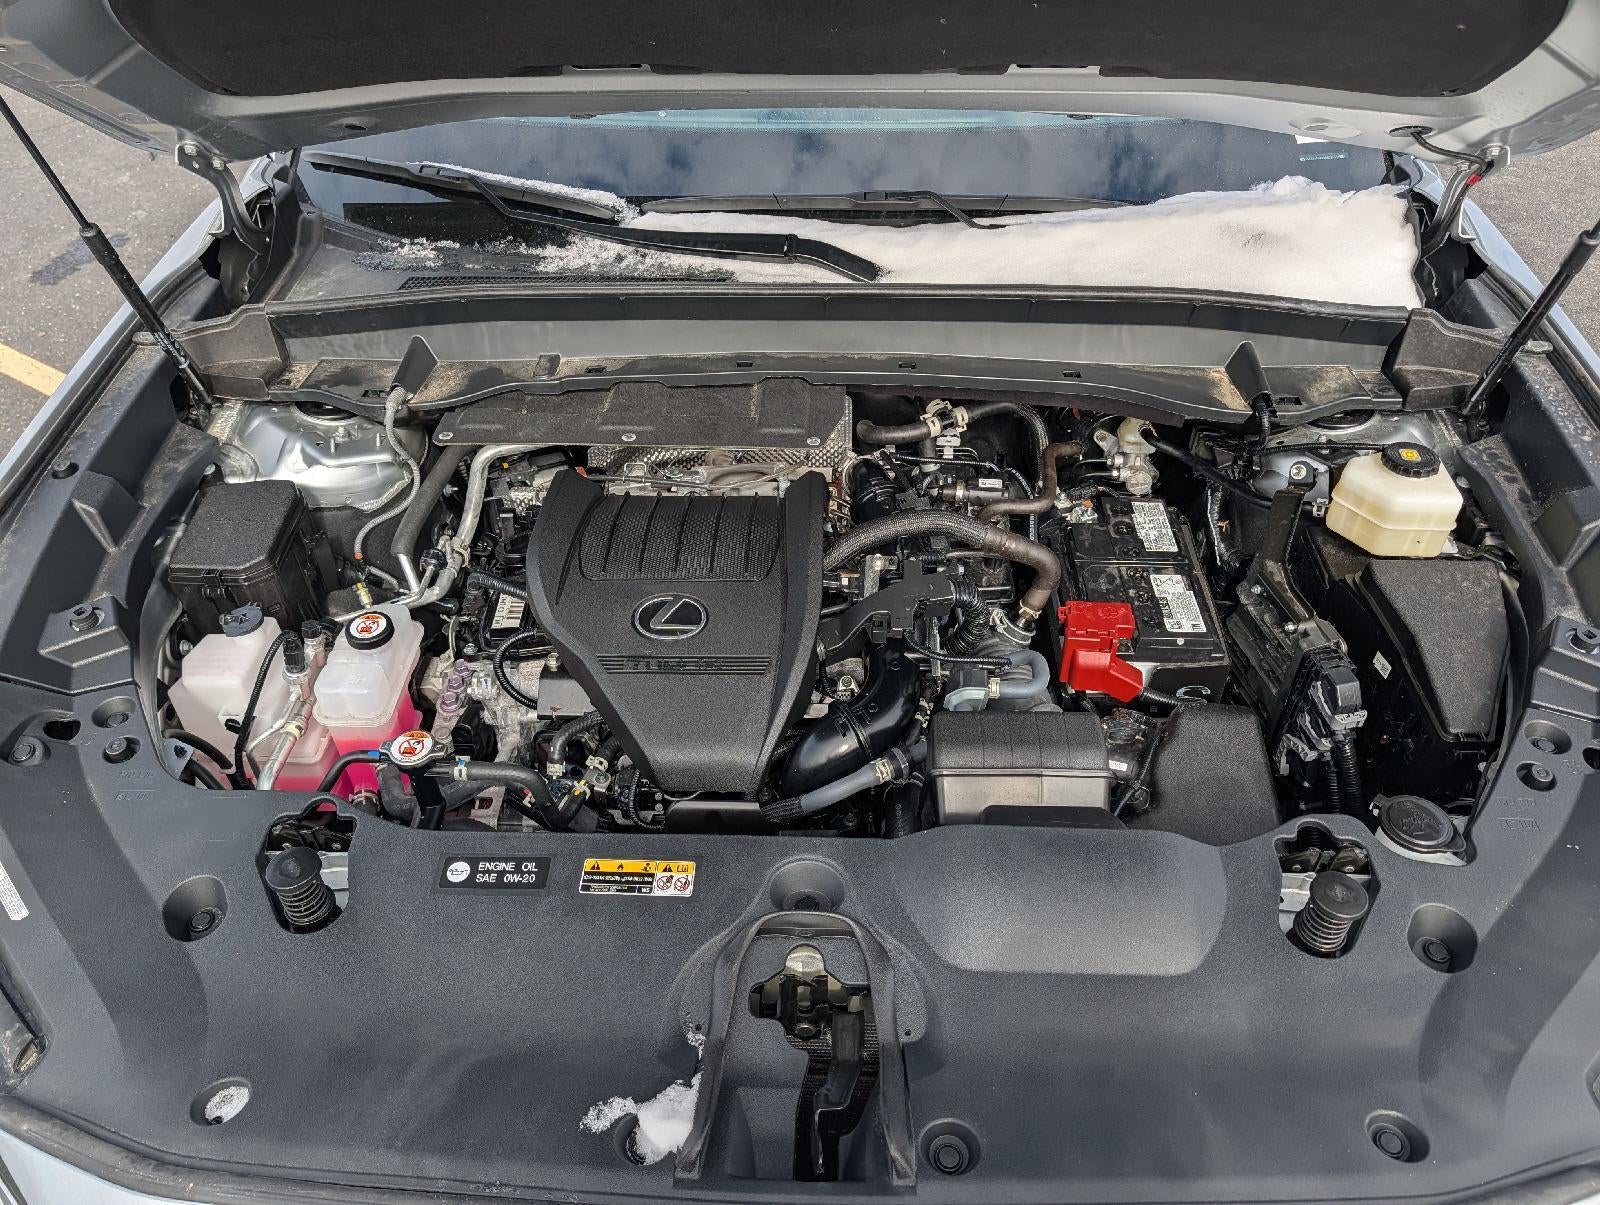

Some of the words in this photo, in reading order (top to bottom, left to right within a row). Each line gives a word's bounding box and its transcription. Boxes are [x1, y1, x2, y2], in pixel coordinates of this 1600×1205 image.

[478, 862, 516, 871] ENGINE
[521, 862, 539, 871] OIL
[475, 873, 498, 883] SAE
[503, 873, 536, 883] 0W-20
